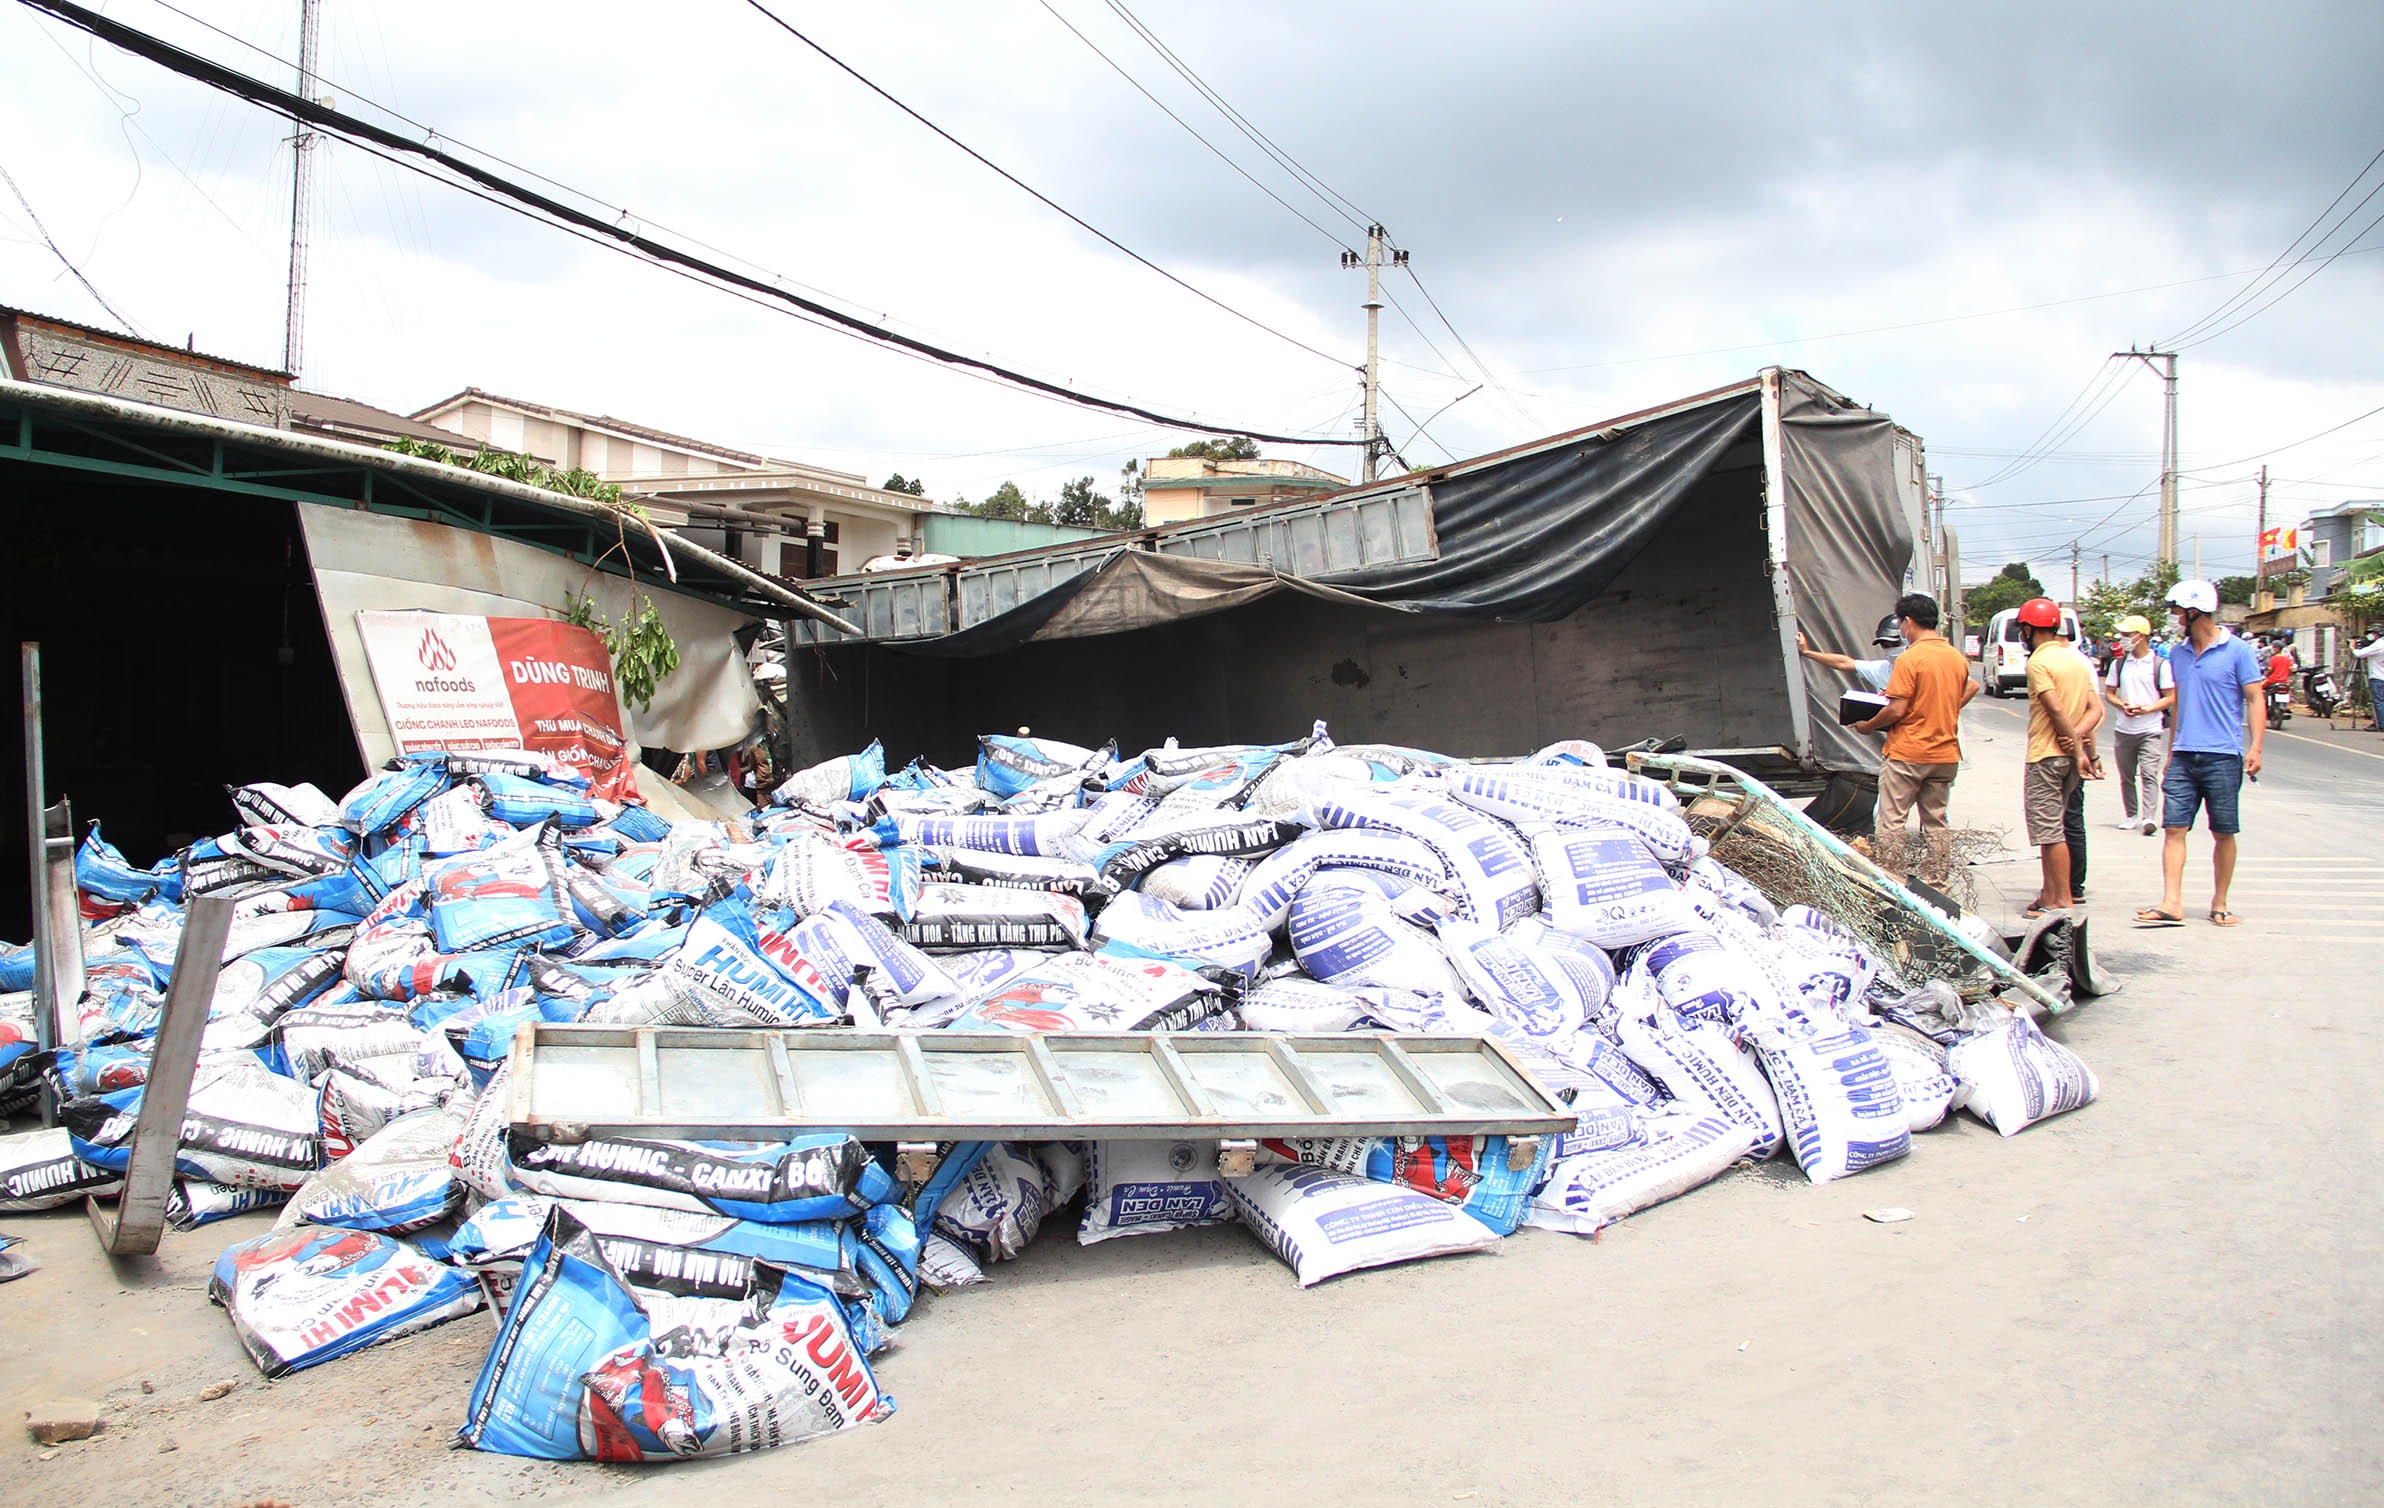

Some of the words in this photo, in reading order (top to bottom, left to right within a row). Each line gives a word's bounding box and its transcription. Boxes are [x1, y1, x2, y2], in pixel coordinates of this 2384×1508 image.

[415, 676, 476, 692] nafoods
[510, 656, 570, 684] DŨNG
[571, 665, 610, 693] TRINH
[395, 717, 426, 730] GIỐNG
[427, 719, 458, 729] CHANH
[460, 720, 475, 729] LEO
[477, 719, 515, 728] NAFOODS
[535, 720, 556, 732] THU
[559, 720, 582, 732] MUA
[271, 844, 316, 868] HUMIC
[1177, 820, 1242, 860] HUMIC
[922, 924, 941, 942] HOA
[951, 922, 975, 942] TĂNG
[674, 957, 709, 986] Super
[709, 974, 739, 999] Lân
[694, 944, 788, 1009] HUMI
[778, 993, 810, 1025] HT
[1680, 1044, 1719, 1089] HUMIC
[218, 1128, 289, 1160] HUMIC
[9, 1161, 77, 1197] HUMIC
[580, 1140, 671, 1176] HUMIC
[690, 1161, 770, 1191] CANXI
[1166, 1183, 1192, 1196] Humic
[652, 1248, 682, 1277] HOA
[717, 1253, 744, 1287] TẠO
[301, 1318, 341, 1350] HT
[775, 1347, 820, 1395] Sung
[818, 1389, 845, 1430] Đạm
